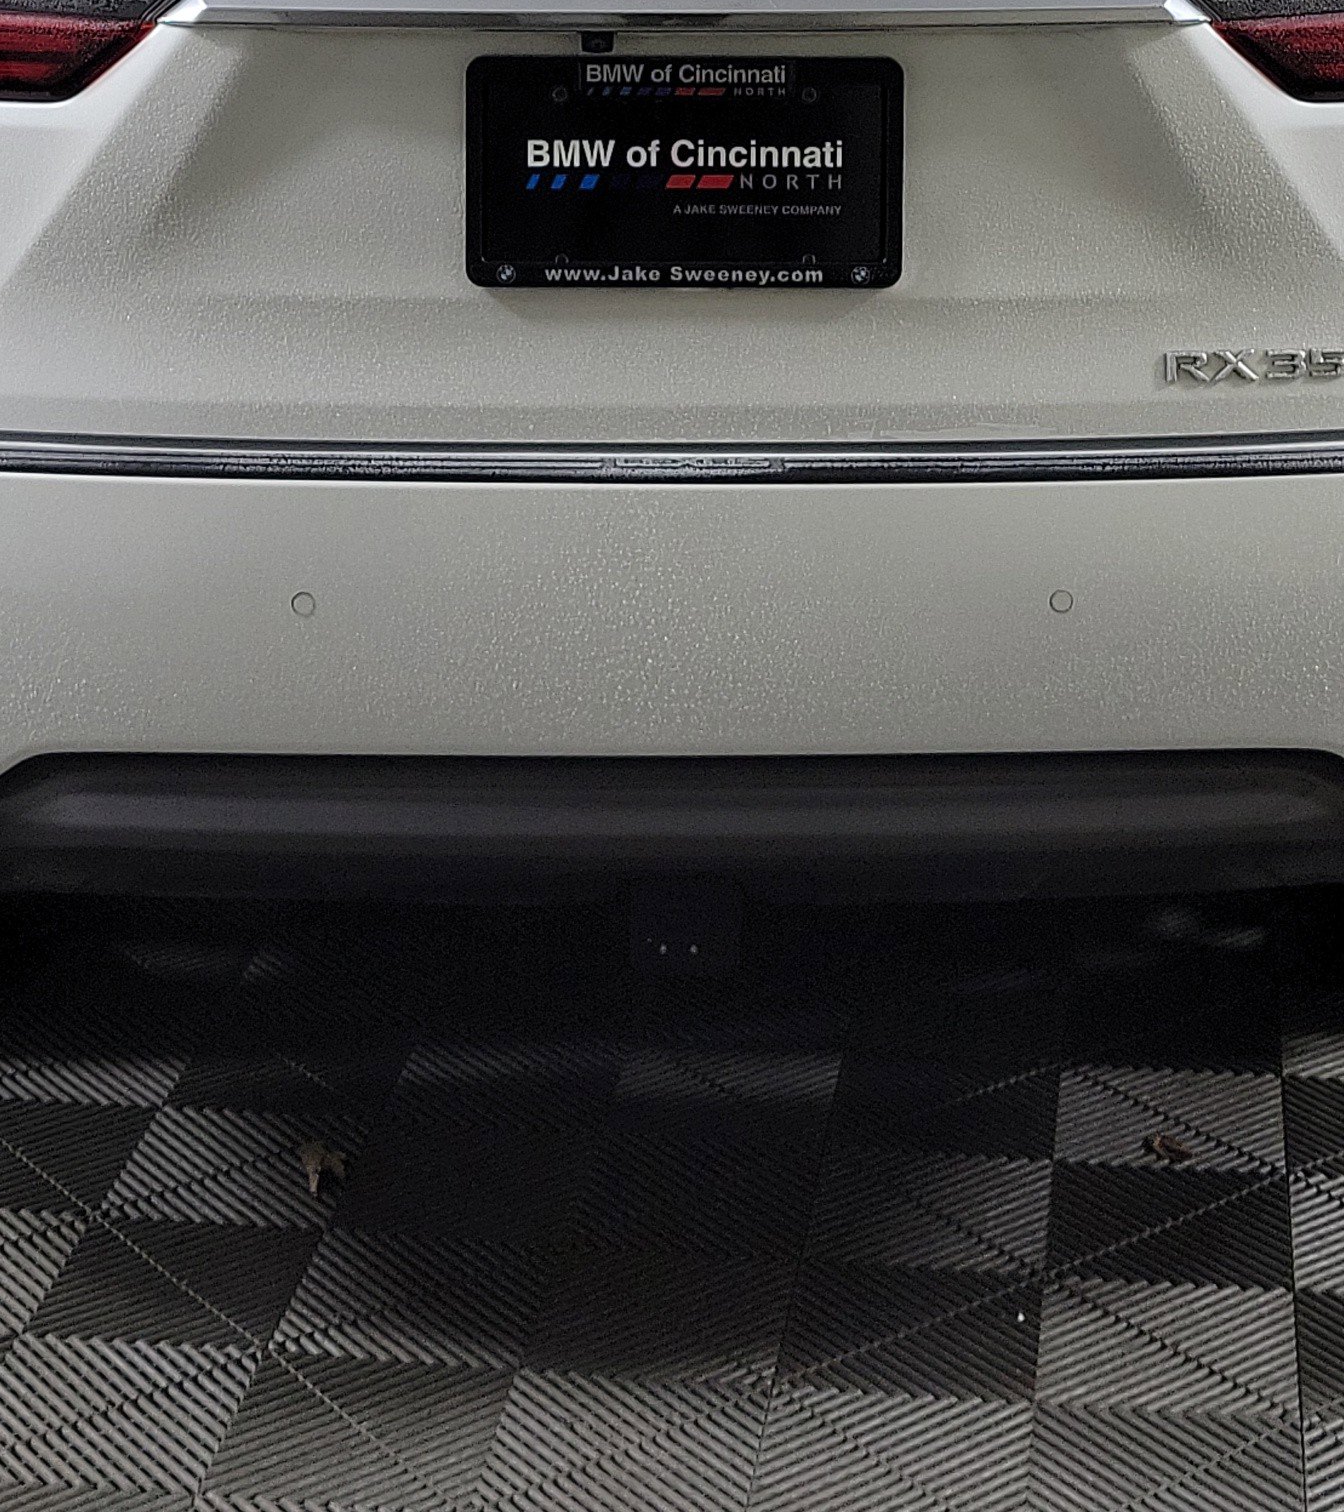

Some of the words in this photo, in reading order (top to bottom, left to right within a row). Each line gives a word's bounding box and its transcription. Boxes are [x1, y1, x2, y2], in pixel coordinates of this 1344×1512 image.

[586, 64, 644, 83] BMW
[651, 64, 672, 83] of
[679, 64, 786, 84] Cincinnati
[526, 139, 615, 168] BMW
[626, 139, 660, 169] of
[670, 139, 843, 169] Cincinnati
[739, 173, 842, 190] NORTH
[673, 205, 682, 215] A
[684, 205, 716, 215] JAKE
[719, 205, 778, 215] SWEENEY
[781, 205, 842, 216] COMPANY
[545, 265, 661, 281] www.Jake
[670, 266, 823, 285] Sweeney.com
